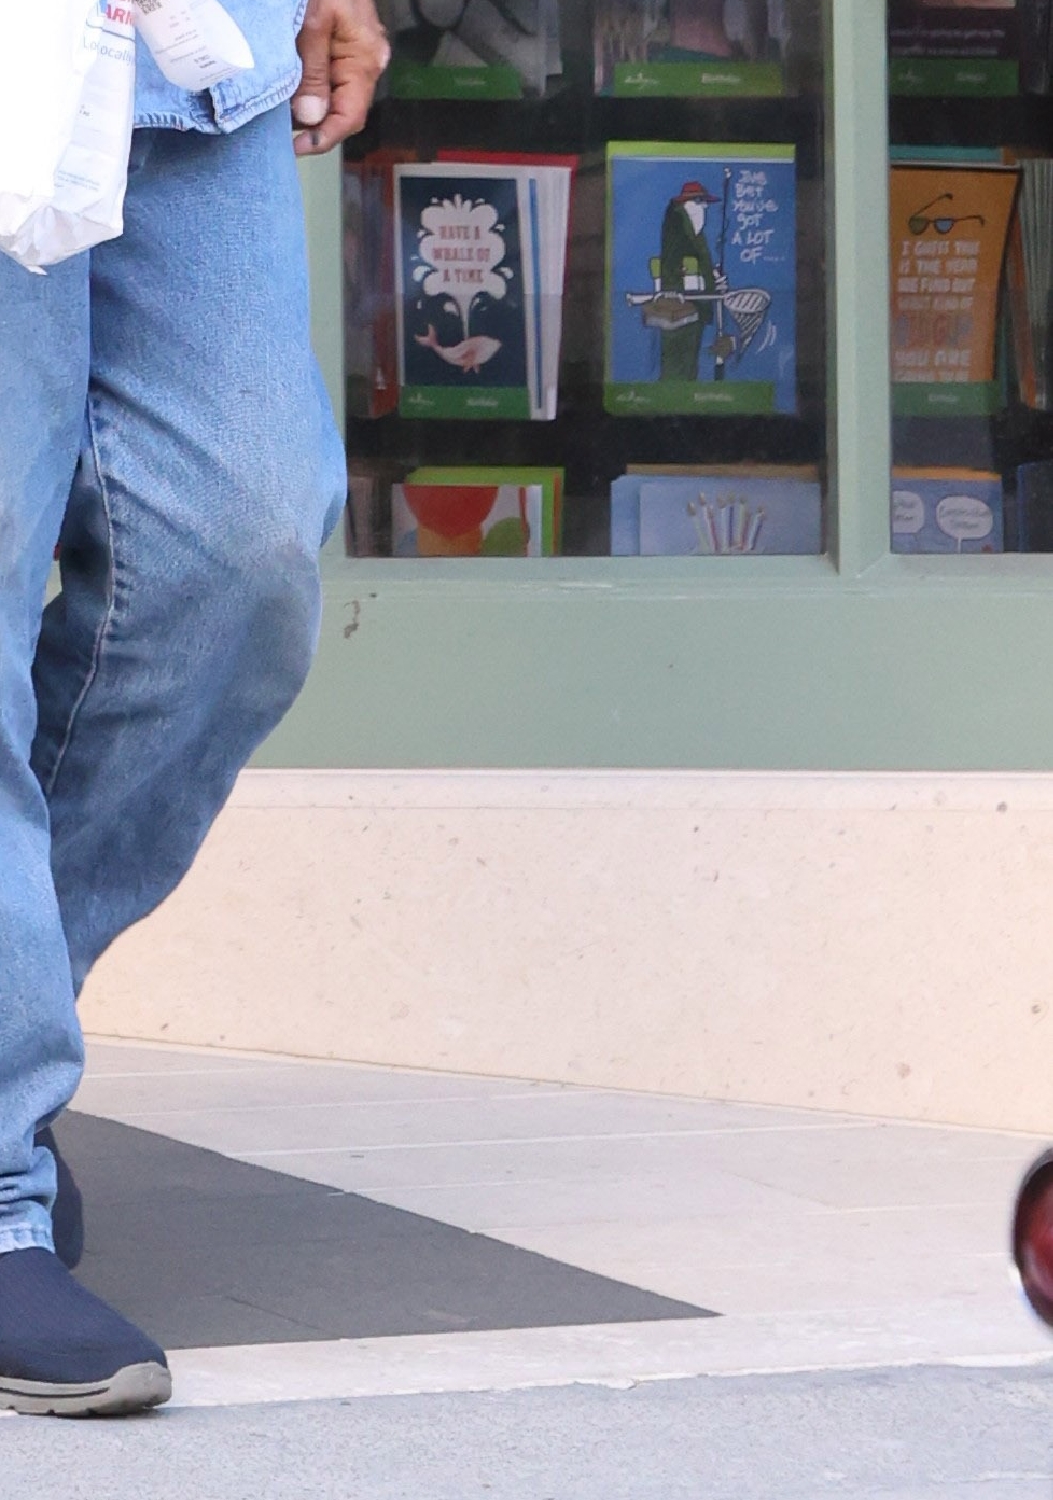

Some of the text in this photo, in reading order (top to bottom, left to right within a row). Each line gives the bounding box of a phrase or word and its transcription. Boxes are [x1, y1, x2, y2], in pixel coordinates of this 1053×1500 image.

[439, 225, 481, 240] HAVE A
[731, 229, 774, 244] A LOT
[432, 247, 474, 262] WHALE
[443, 268, 485, 283] A TIME
